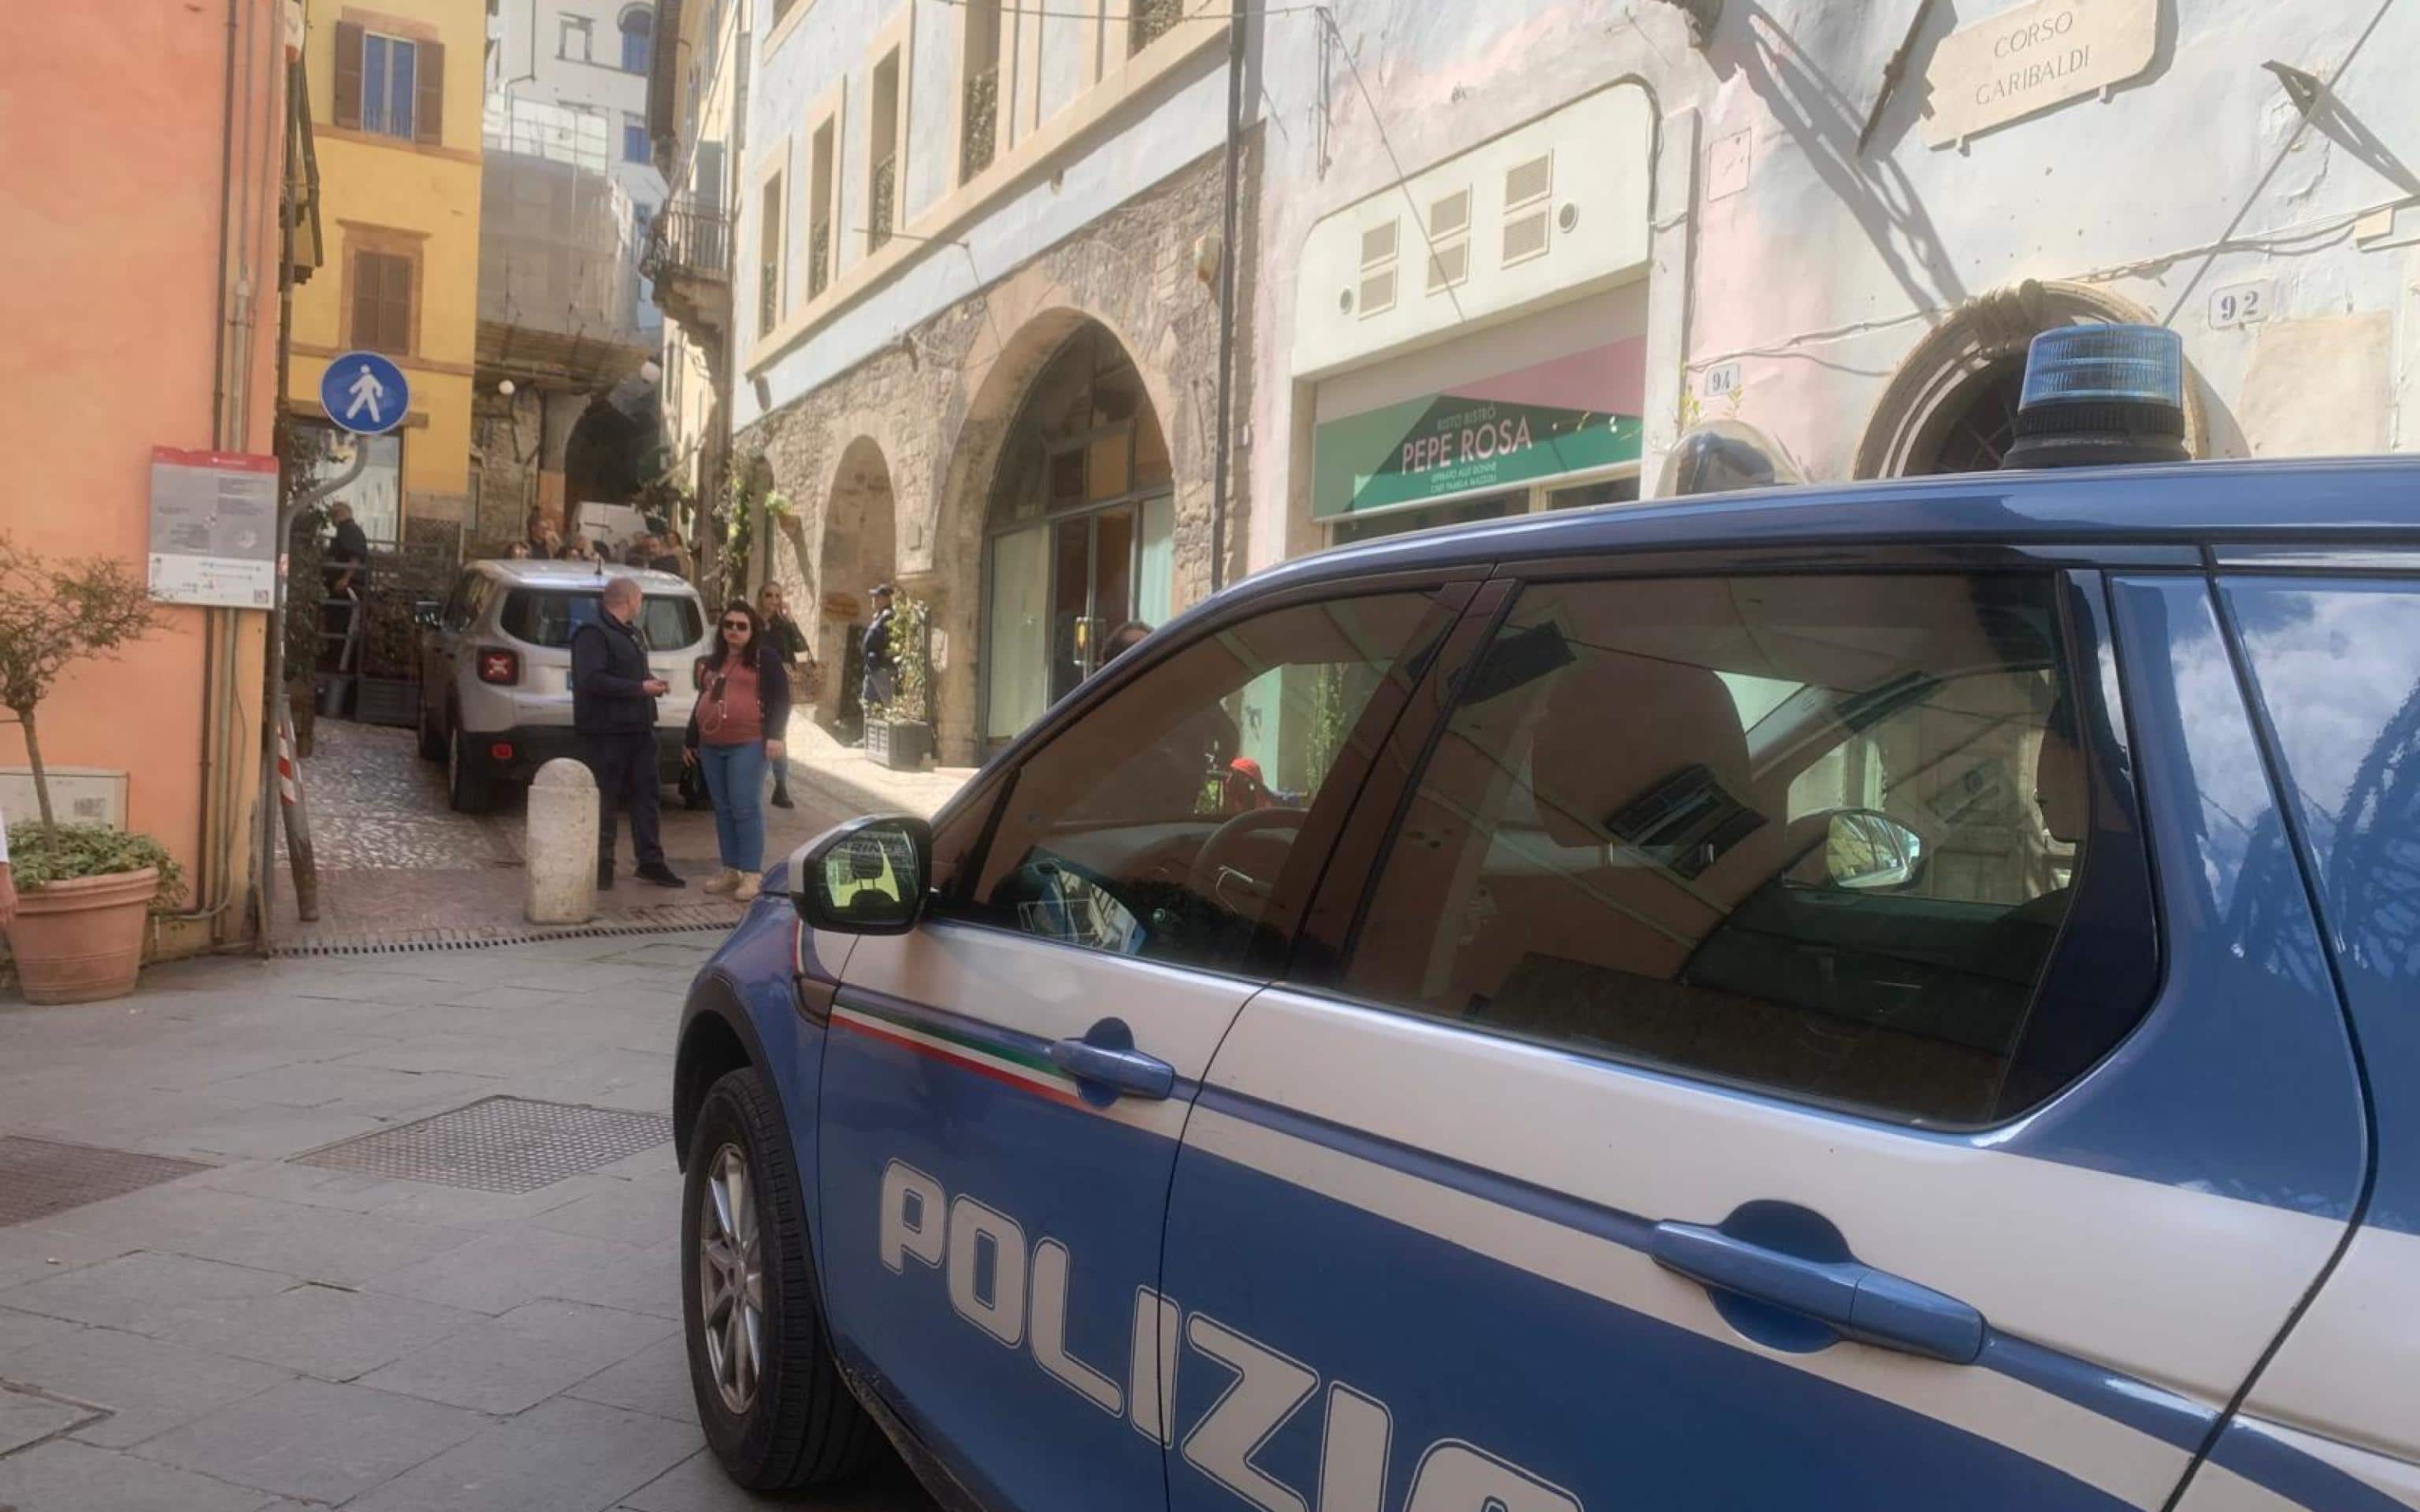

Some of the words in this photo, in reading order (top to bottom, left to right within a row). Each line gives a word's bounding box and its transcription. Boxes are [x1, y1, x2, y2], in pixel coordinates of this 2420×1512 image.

[1994, 11, 2073, 59] CORSO
[1976, 45, 2090, 106] GARIBALDI
[2221, 290, 2259, 321] 92
[1713, 369, 1731, 392] 94
[1401, 432, 1453, 476] PEPE
[1461, 415, 1533, 463] ROSA
